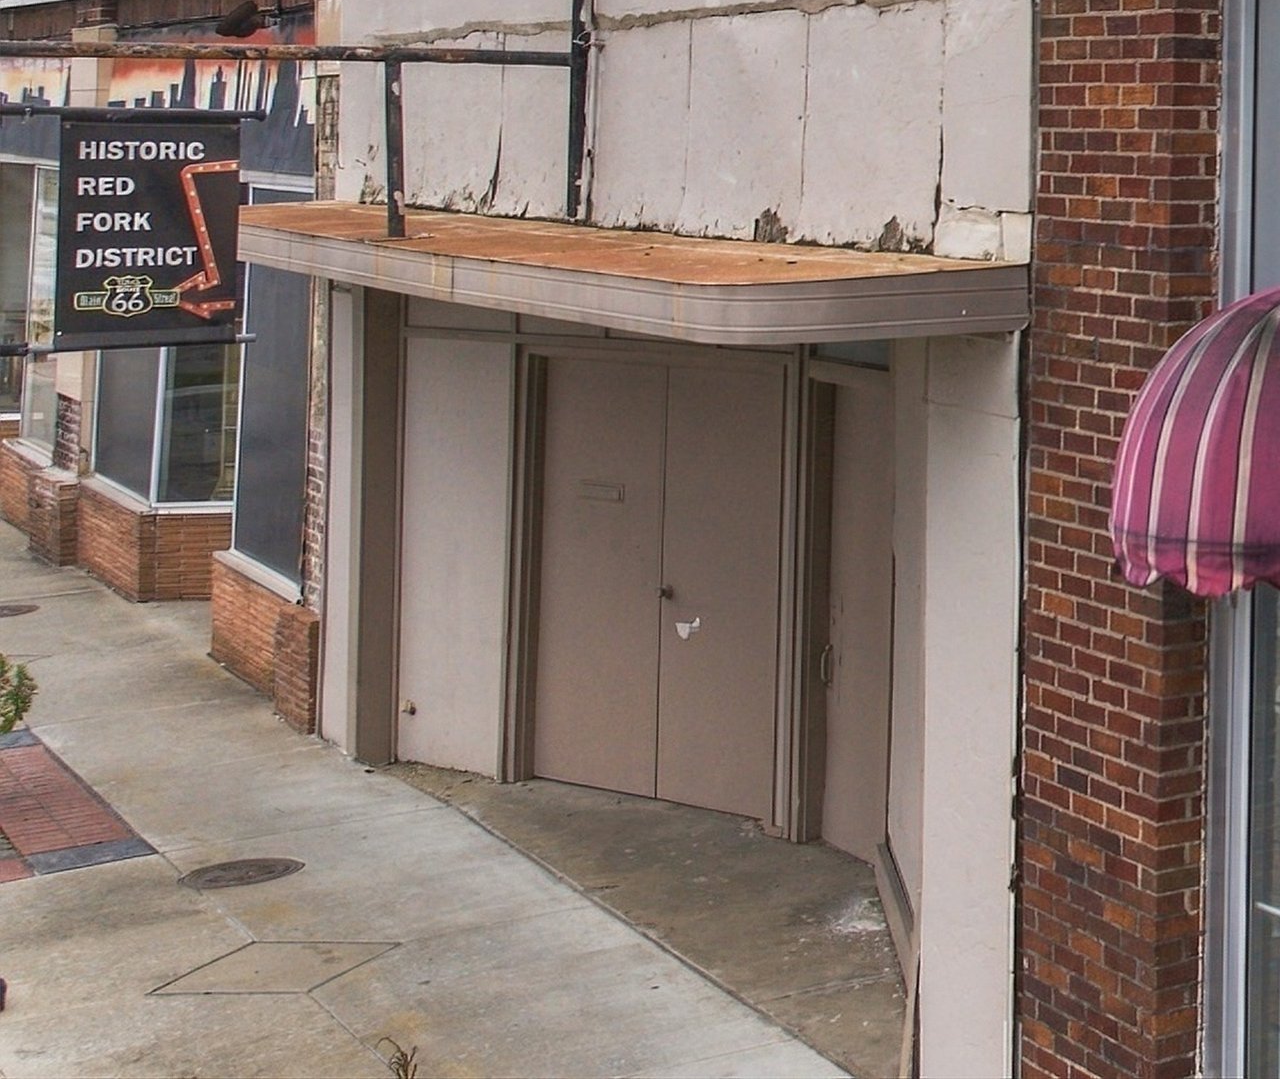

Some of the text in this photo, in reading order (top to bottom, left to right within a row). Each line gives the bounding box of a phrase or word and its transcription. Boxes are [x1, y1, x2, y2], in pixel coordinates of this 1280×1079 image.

[78, 140, 206, 161] HISTORIC
[77, 176, 136, 196] RED
[76, 212, 152, 232] FORK
[75, 246, 198, 269] DISTRICT
[111, 292, 145, 312] 66
